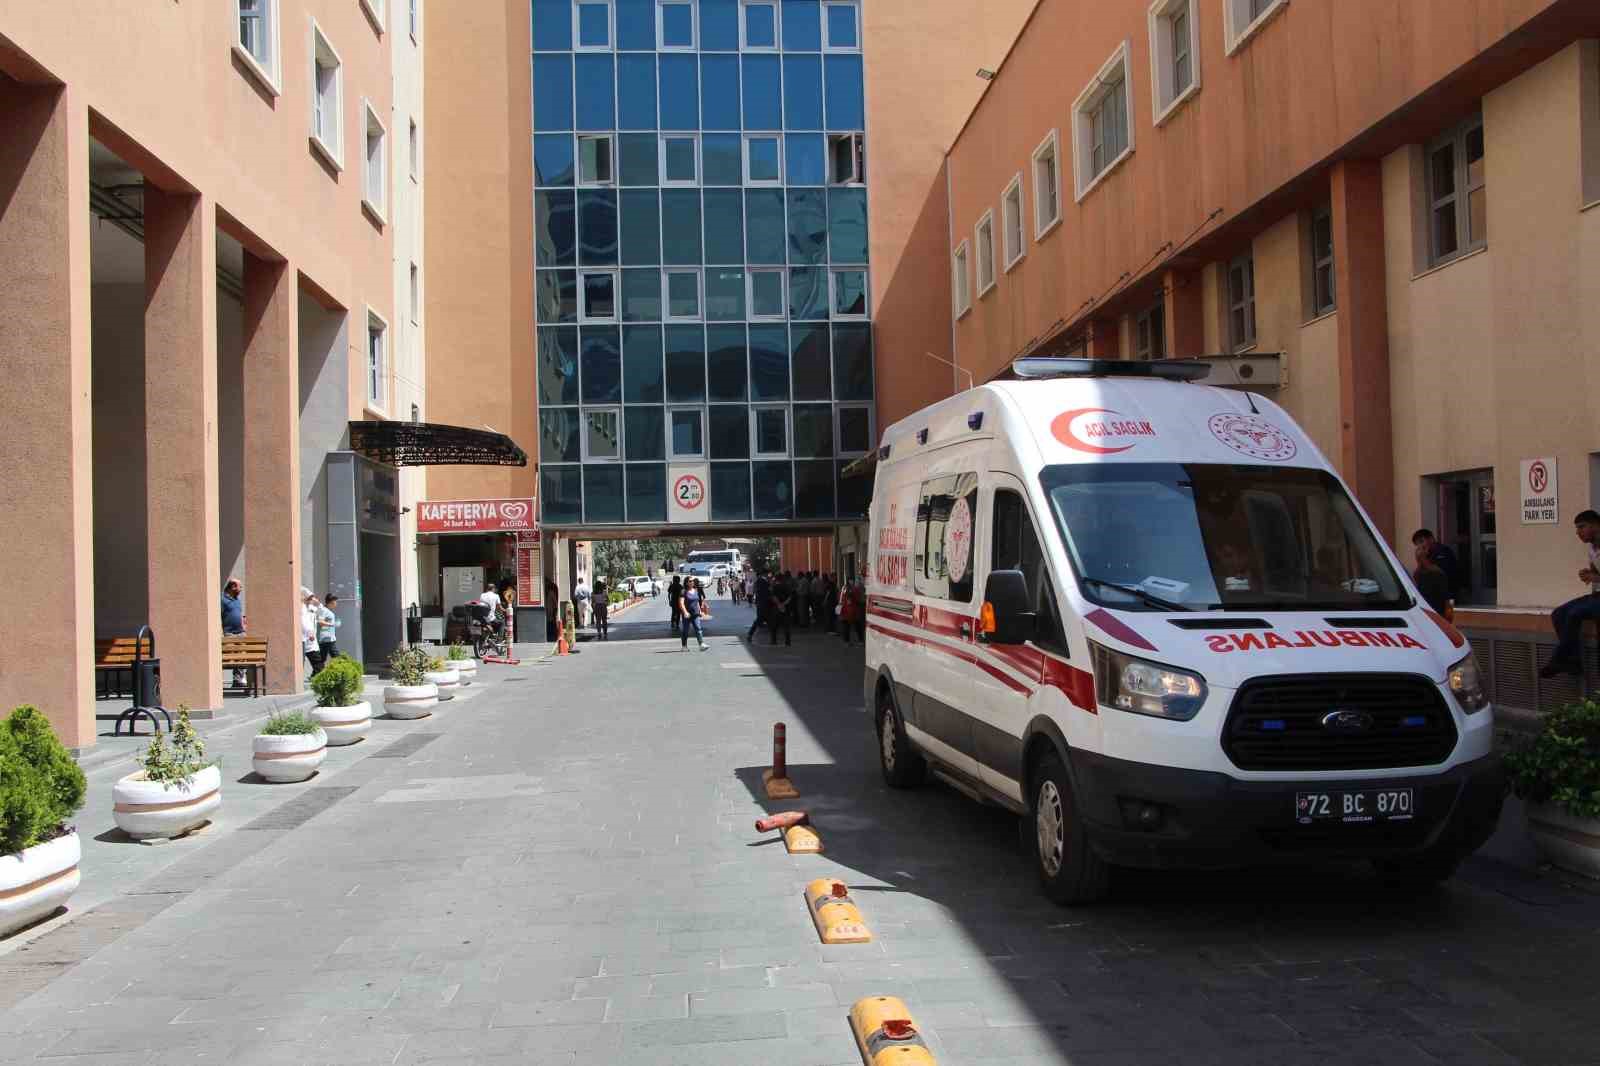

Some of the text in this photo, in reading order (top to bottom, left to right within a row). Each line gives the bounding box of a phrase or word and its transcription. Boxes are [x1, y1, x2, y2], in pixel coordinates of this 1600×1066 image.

[680, 485, 689, 499] 2
[421, 503, 497, 520] KAFETERYA
[1524, 510, 1539, 520] PARK
[500, 520, 528, 528] ALGIDA
[1308, 792, 1409, 814] 72 BC 870
